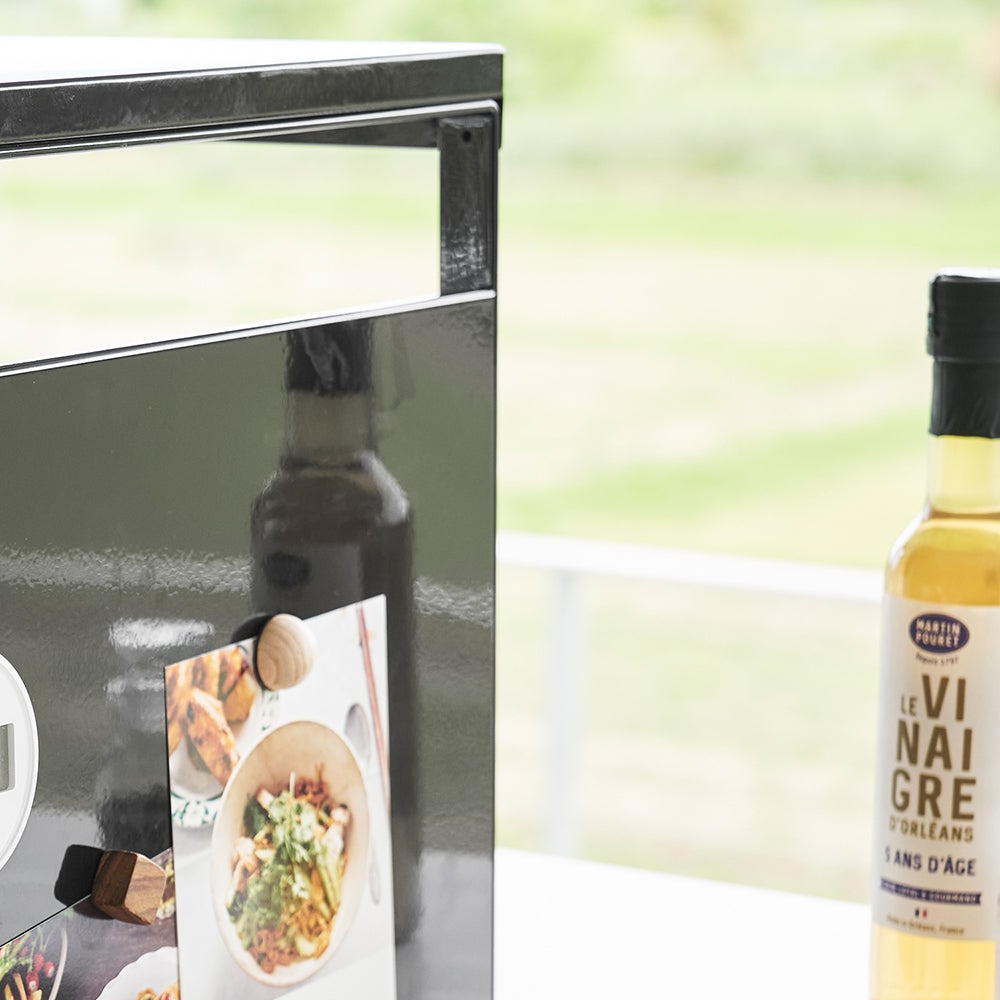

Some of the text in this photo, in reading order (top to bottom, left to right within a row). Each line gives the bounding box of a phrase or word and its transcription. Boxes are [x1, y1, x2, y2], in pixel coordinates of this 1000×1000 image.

[914, 630, 960, 649] POURET
[915, 618, 960, 637] MARTIN
[900, 673, 967, 722] LE VI
[896, 719, 973, 772] NAI
[891, 768, 977, 821] GRE
[889, 815, 974, 843] D'ORLÉANS
[893, 849, 923, 871] ANS
